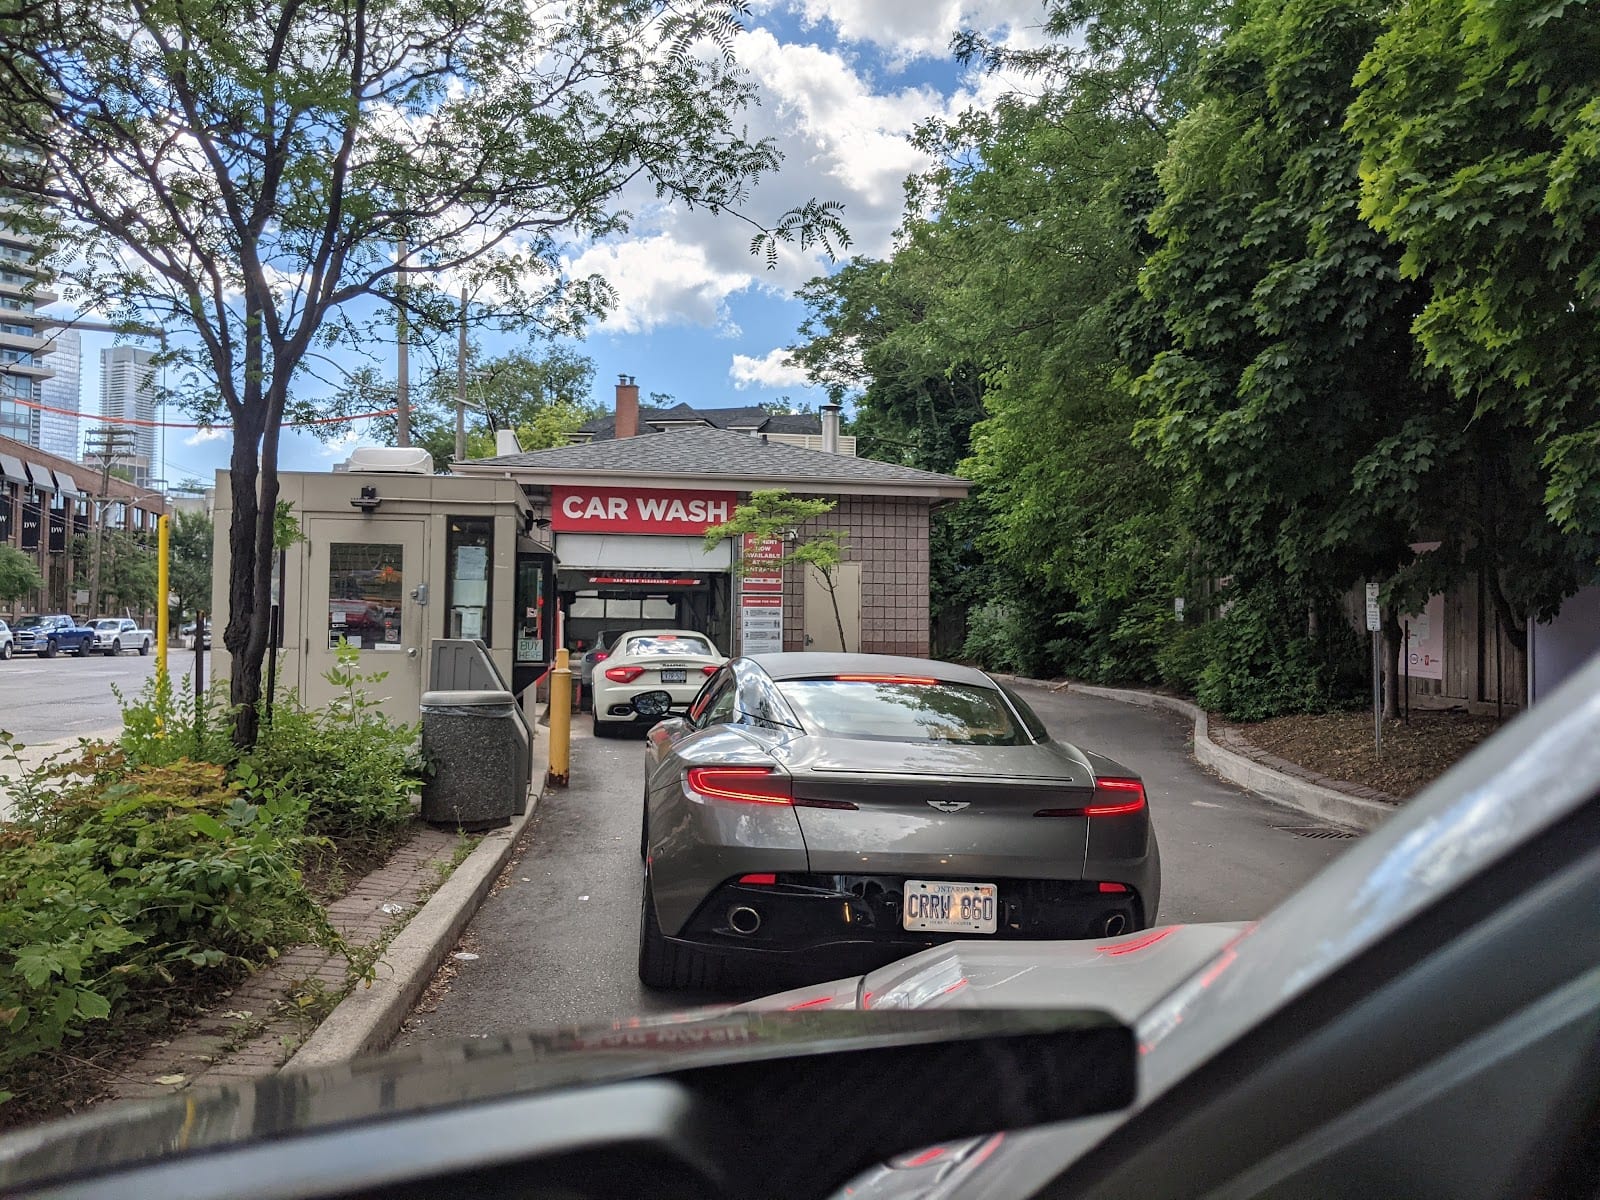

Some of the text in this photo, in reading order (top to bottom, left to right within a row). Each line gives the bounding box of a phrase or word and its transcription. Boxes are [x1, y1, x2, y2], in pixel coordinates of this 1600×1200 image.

[562, 495, 728, 523] CAR WASH
[520, 641, 539, 650] BUY
[934, 885, 970, 893] ONTARIO
[909, 894, 993, 920] CRRW 860
